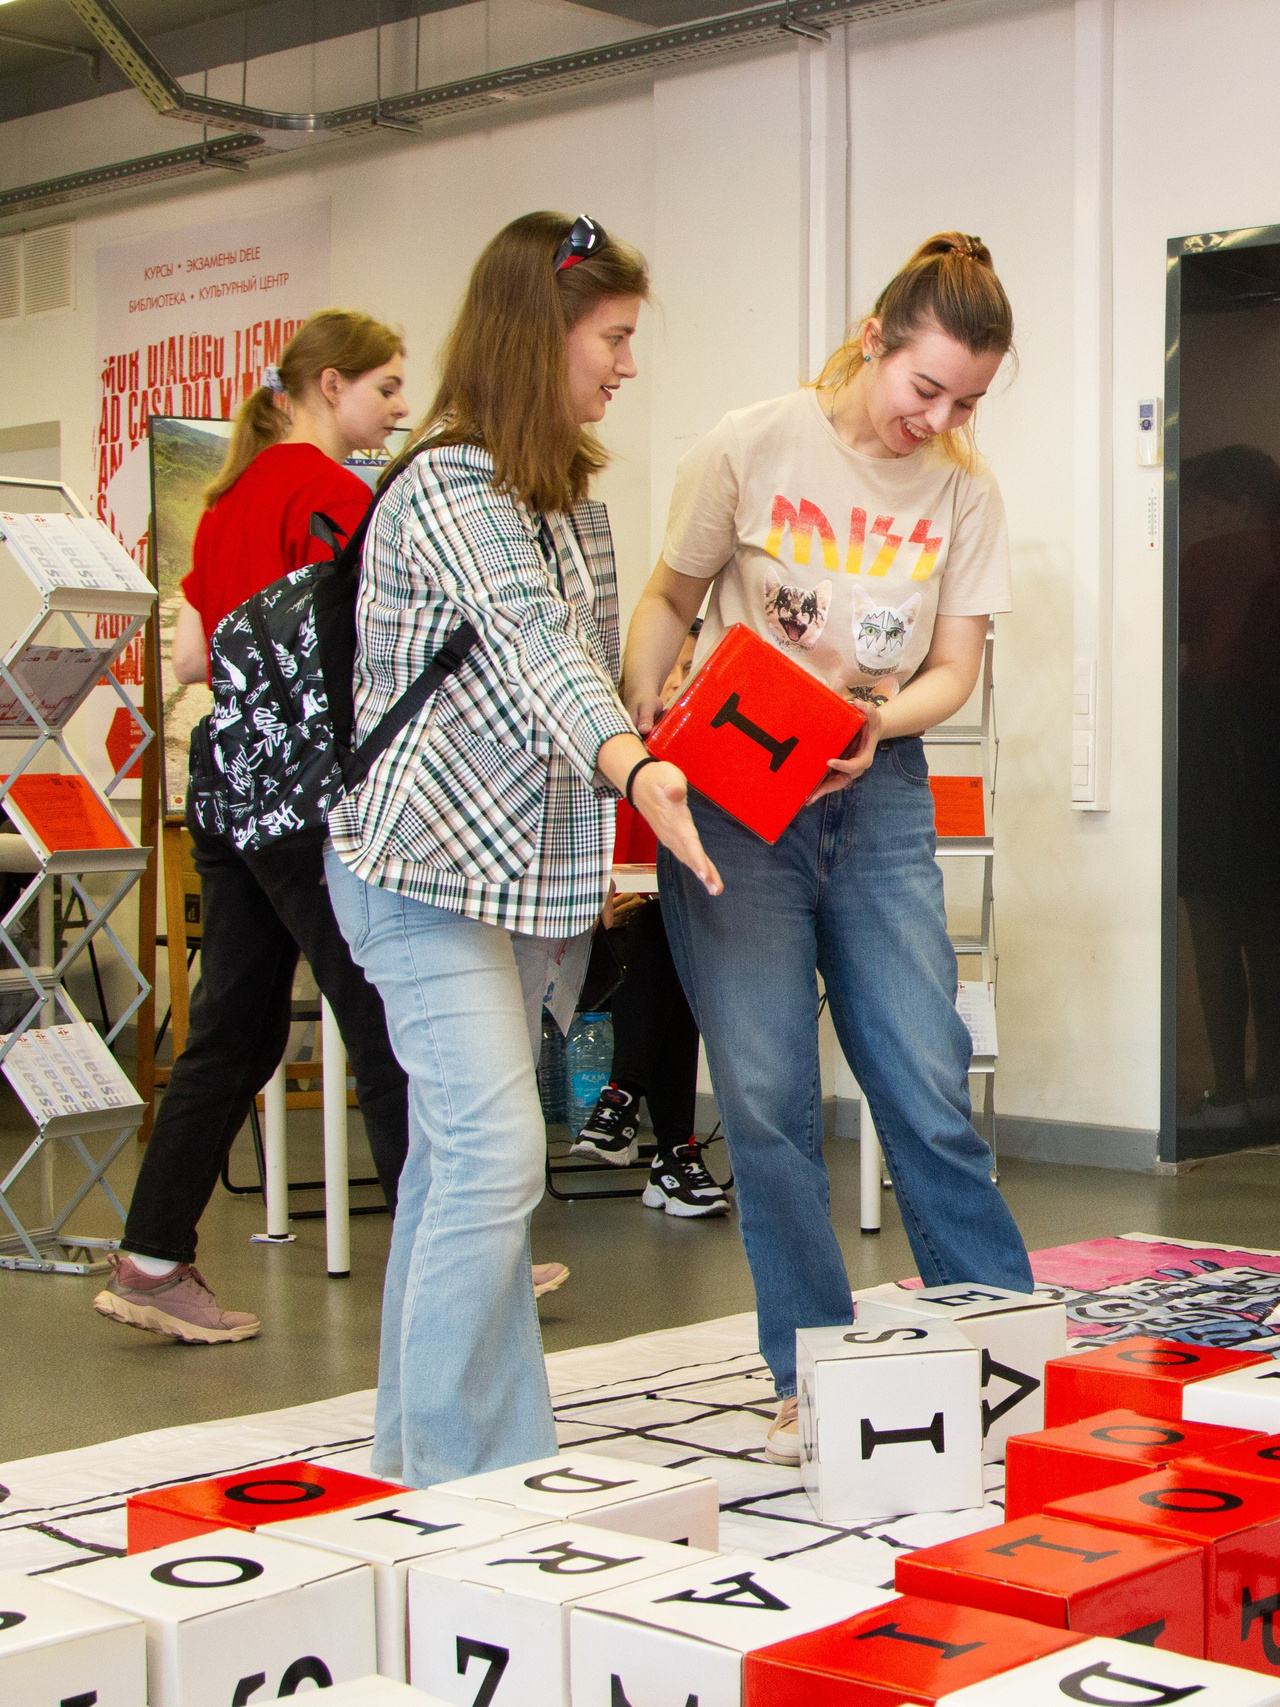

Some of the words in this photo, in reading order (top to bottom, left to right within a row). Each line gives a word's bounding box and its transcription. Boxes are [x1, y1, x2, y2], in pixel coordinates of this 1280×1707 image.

[144, 264, 174, 280] КУРСЫ
[186, 250, 237, 273] ЭКЗАМЕНЫ
[239, 246, 261, 262] DELE
[129, 292, 186, 313] БИБЛИОТЕКА
[199, 276, 257, 300] КУЛЬТУРНЫЙ
[259, 272, 290, 292] ЦЕНТР
[765, 494, 944, 582] MISS
[709, 691, 800, 774] I
[1116, 1350, 1200, 1366] O
[860, 1412, 945, 1460] I
[1090, 1426, 1184, 1446] O
[224, 1479, 325, 1505] O
[1138, 1488, 1244, 1513] O
[150, 1555, 264, 1588] O
[484, 1540, 647, 1575] R
[650, 1571, 791, 1611] A
